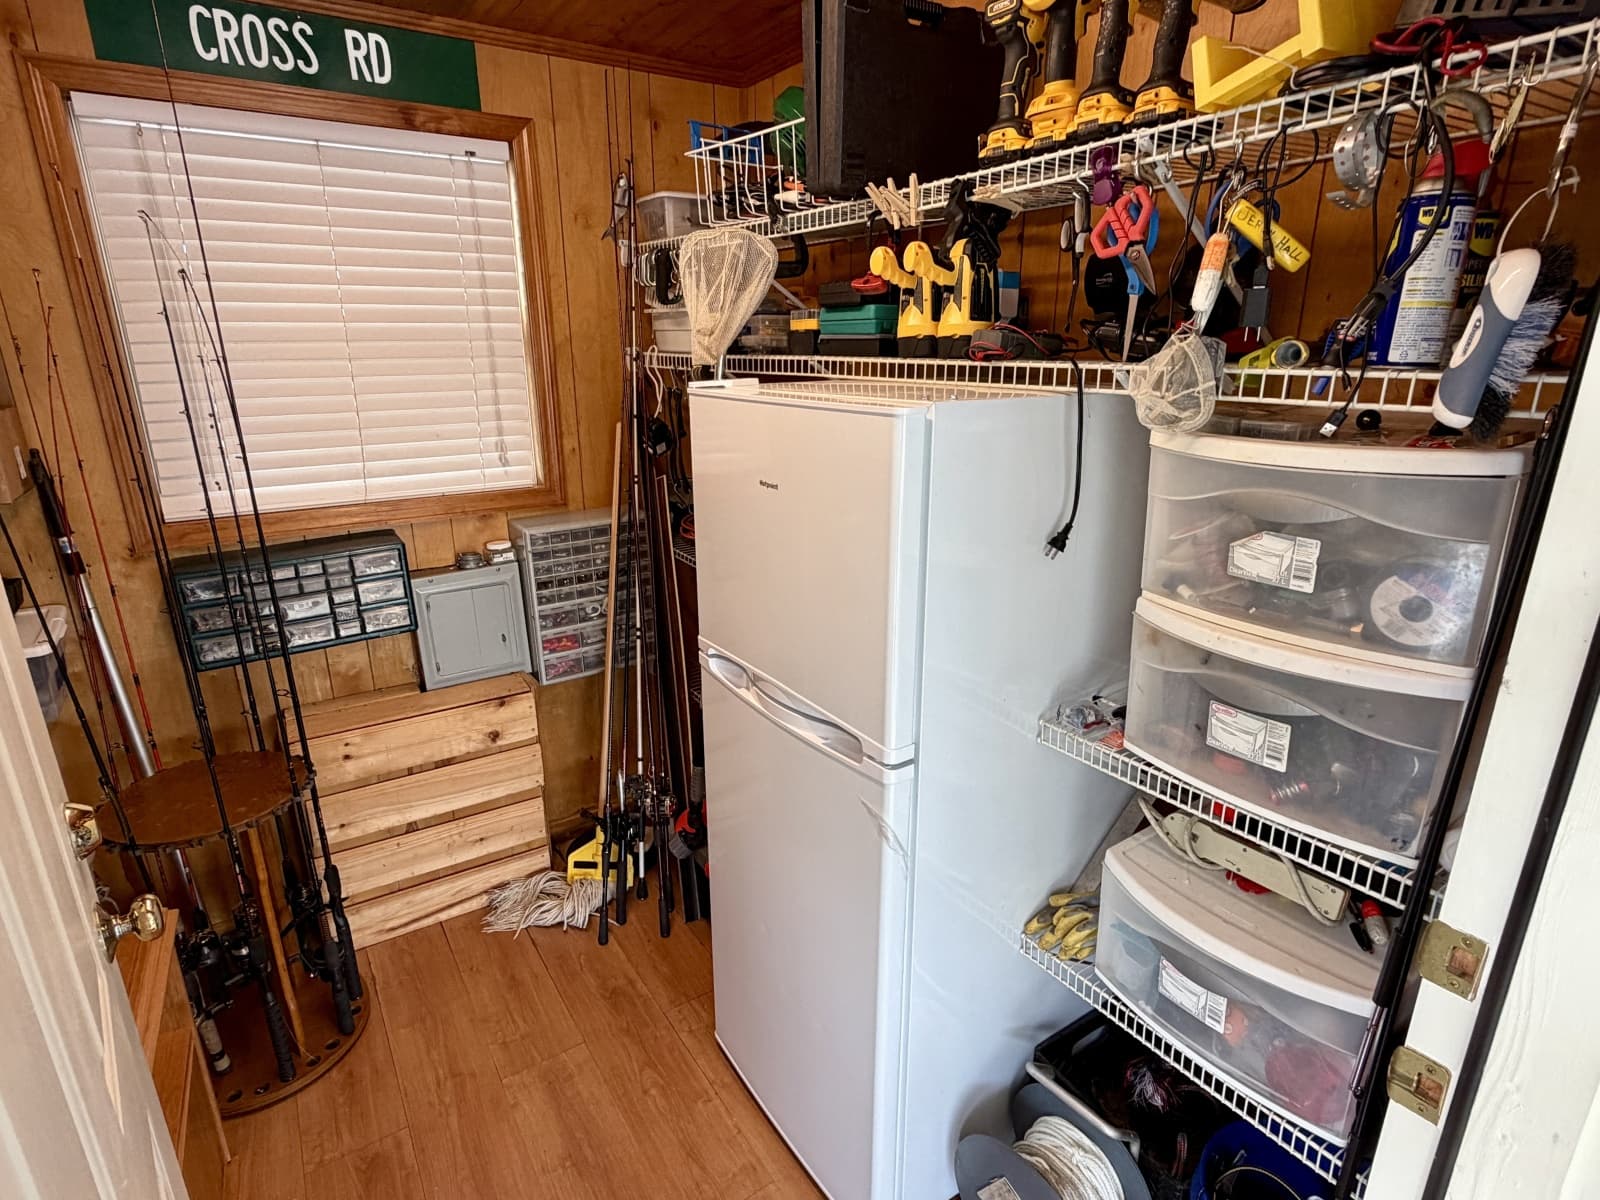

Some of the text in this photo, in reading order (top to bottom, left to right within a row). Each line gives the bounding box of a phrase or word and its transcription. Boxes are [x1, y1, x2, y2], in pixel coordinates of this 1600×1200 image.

[188, 4, 392, 85] CROSS RD
[1275, 235, 1303, 261] HALL
